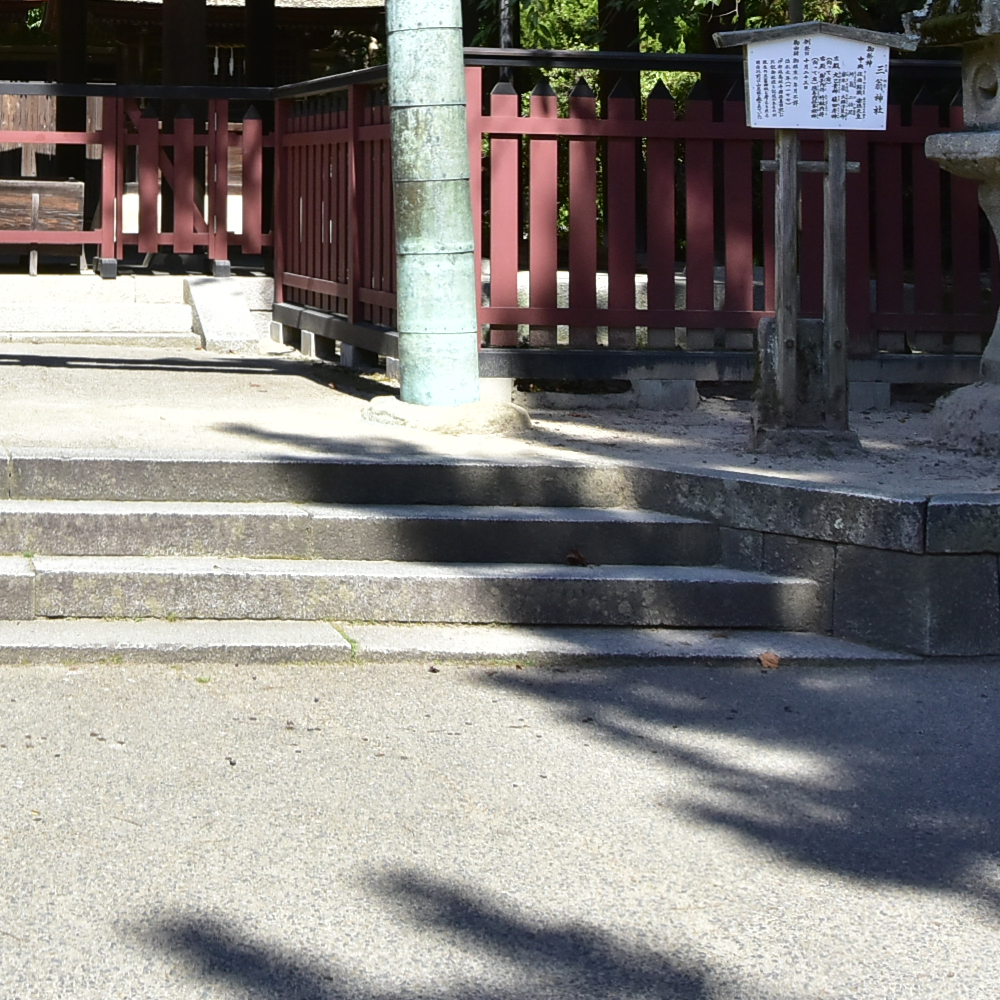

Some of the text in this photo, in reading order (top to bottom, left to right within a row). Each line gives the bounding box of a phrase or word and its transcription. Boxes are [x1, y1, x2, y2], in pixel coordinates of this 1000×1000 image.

[865, 46, 875, 67] 御祭神
[873, 65, 885, 115] 三翁神社
